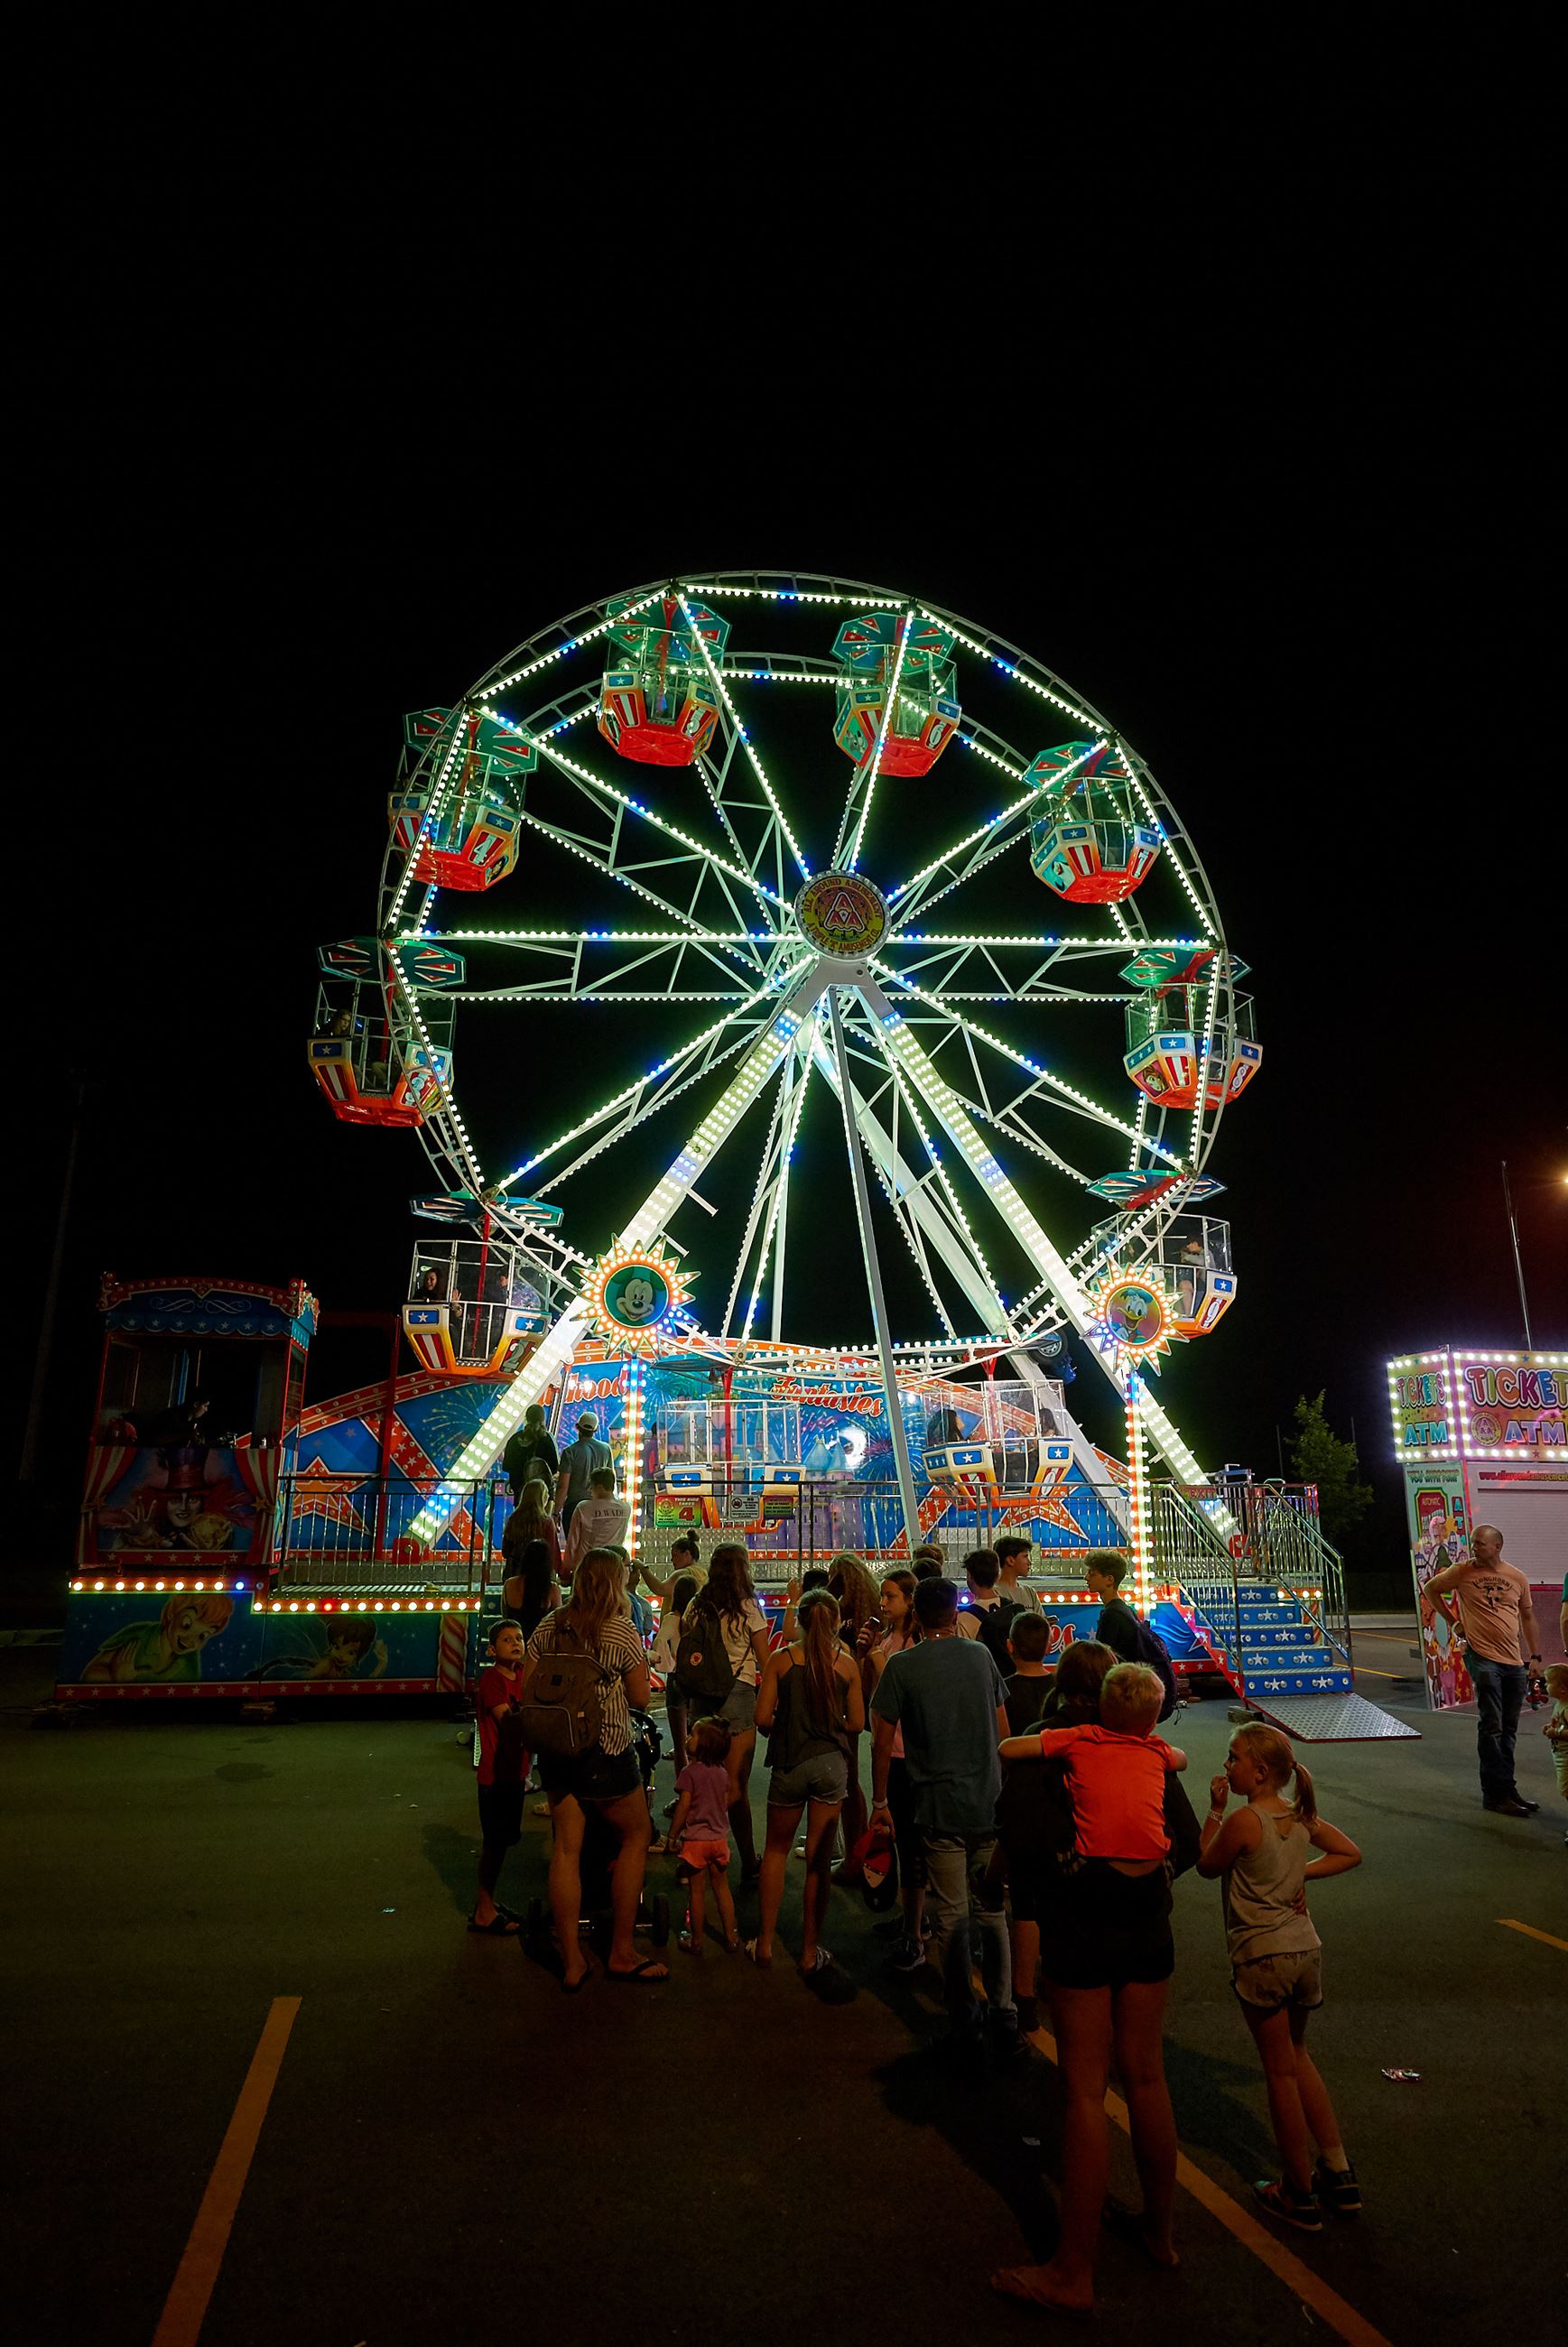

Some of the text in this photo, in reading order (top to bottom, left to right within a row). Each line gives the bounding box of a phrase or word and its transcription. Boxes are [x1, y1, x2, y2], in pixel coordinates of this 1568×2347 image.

[473, 838, 493, 863] 4
[1135, 851, 1149, 876] 7
[811, 878, 841, 895] AROUND
[845, 879, 883, 919] AMUSEMENT
[1232, 1066, 1247, 1089] 8
[1203, 1301, 1220, 1323] 9
[503, 1342, 524, 1369] 2
[770, 1377, 884, 1417] Fantasies
[1396, 1371, 1446, 1407] TICKETS
[1464, 1365, 1568, 1408] TICKET
[1405, 1420, 1448, 1446] ATM
[1504, 1420, 1566, 1445] ATM
[1189, 1487, 1215, 1499] EXIT
[679, 1506, 695, 1522] 4
